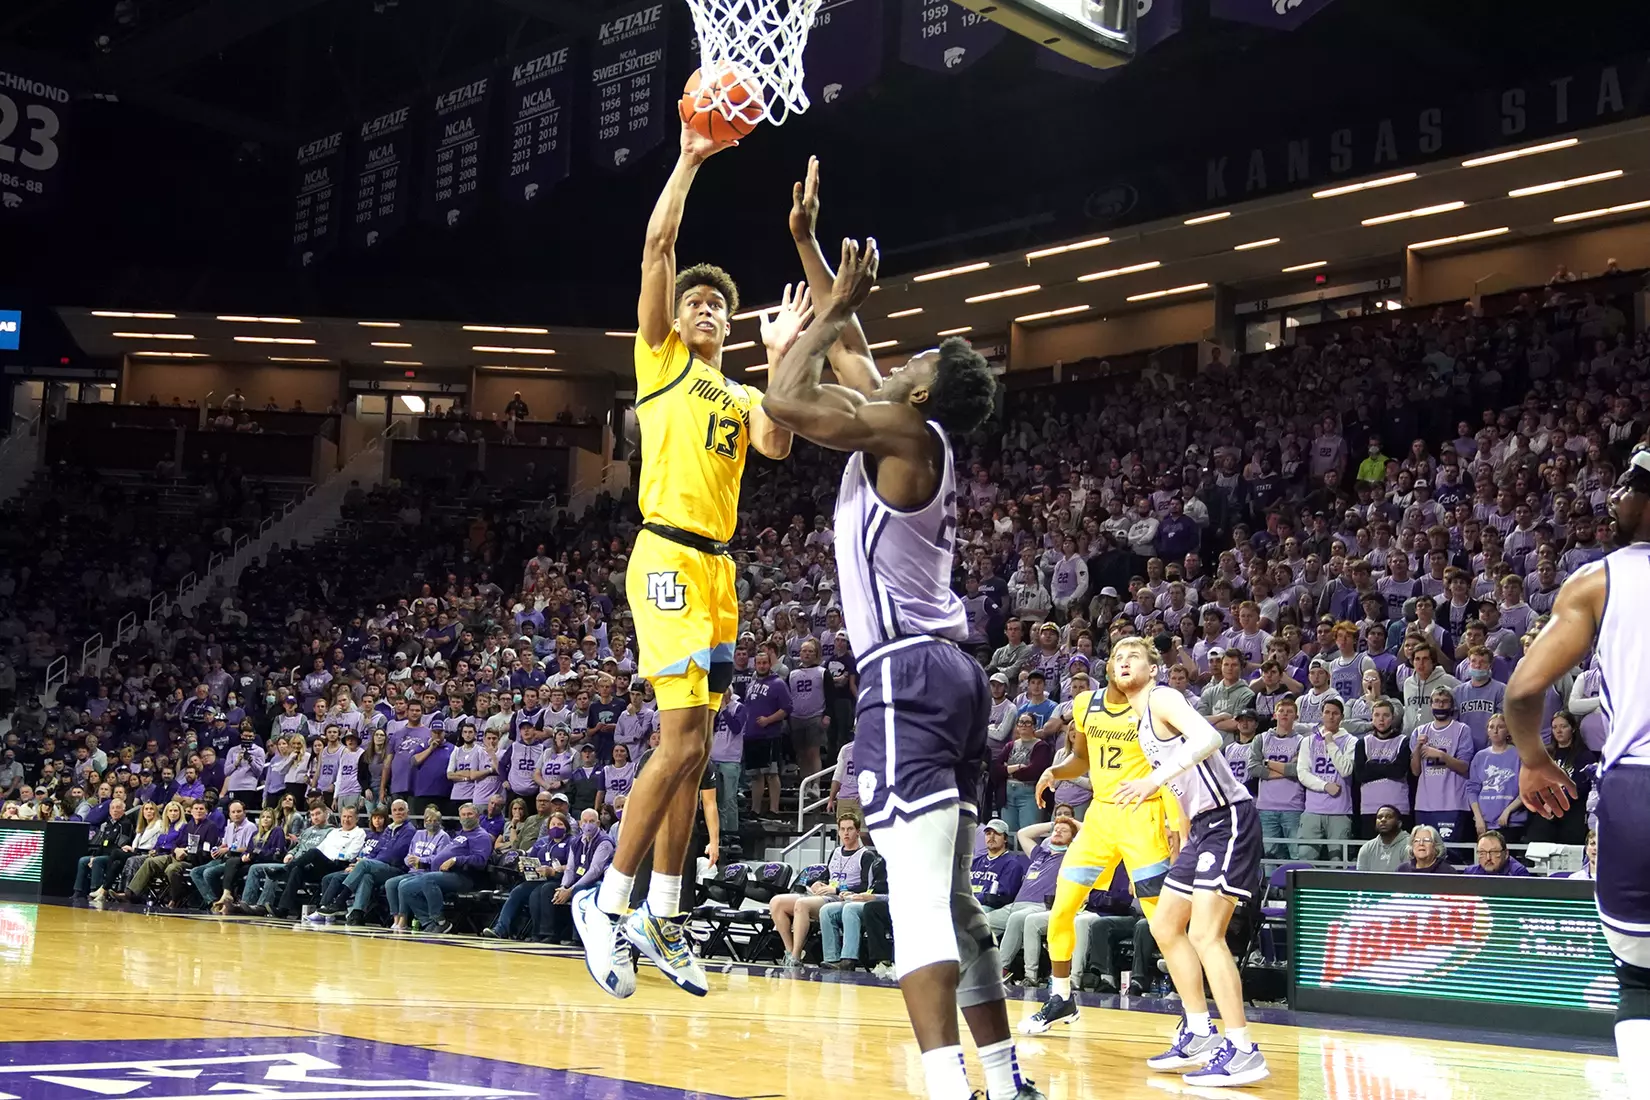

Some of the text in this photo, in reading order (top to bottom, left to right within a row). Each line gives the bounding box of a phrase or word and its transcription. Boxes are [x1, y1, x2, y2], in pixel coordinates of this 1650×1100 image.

[598, 4, 663, 41] K-STATE
[810, 13, 831, 29] 018
[921, 4, 949, 22] 1959
[921, 21, 947, 39] 1961
[511, 46, 568, 82] K-STATE
[592, 48, 662, 82] SWEET SIXTEEN
[619, 49, 637, 61] NCAA
[435, 78, 488, 111] K-STATE
[602, 74, 651, 98] 1951 1961
[522, 87, 552, 110] NCAA
[601, 88, 650, 112] 1956 1964
[445, 116, 473, 138] NCAA
[514, 112, 559, 137] 2011 2017
[599, 116, 648, 140] 1959 1970
[600, 112, 620, 126] 1958
[1206, 56, 1650, 201] KANSAS STA
[513, 126, 558, 150] 2012 2018
[368, 143, 394, 162] NCAA
[512, 140, 557, 163] 2013 2019
[510, 162, 530, 176] 2014
[0, 172, 43, 194] 86-88
[705, 411, 742, 460] 13
[797, 680, 812, 692] 22
[519, 759, 535, 771] 22
[1099, 746, 1122, 769] 12
[544, 763, 561, 776] 22
[610, 779, 627, 791] 22
